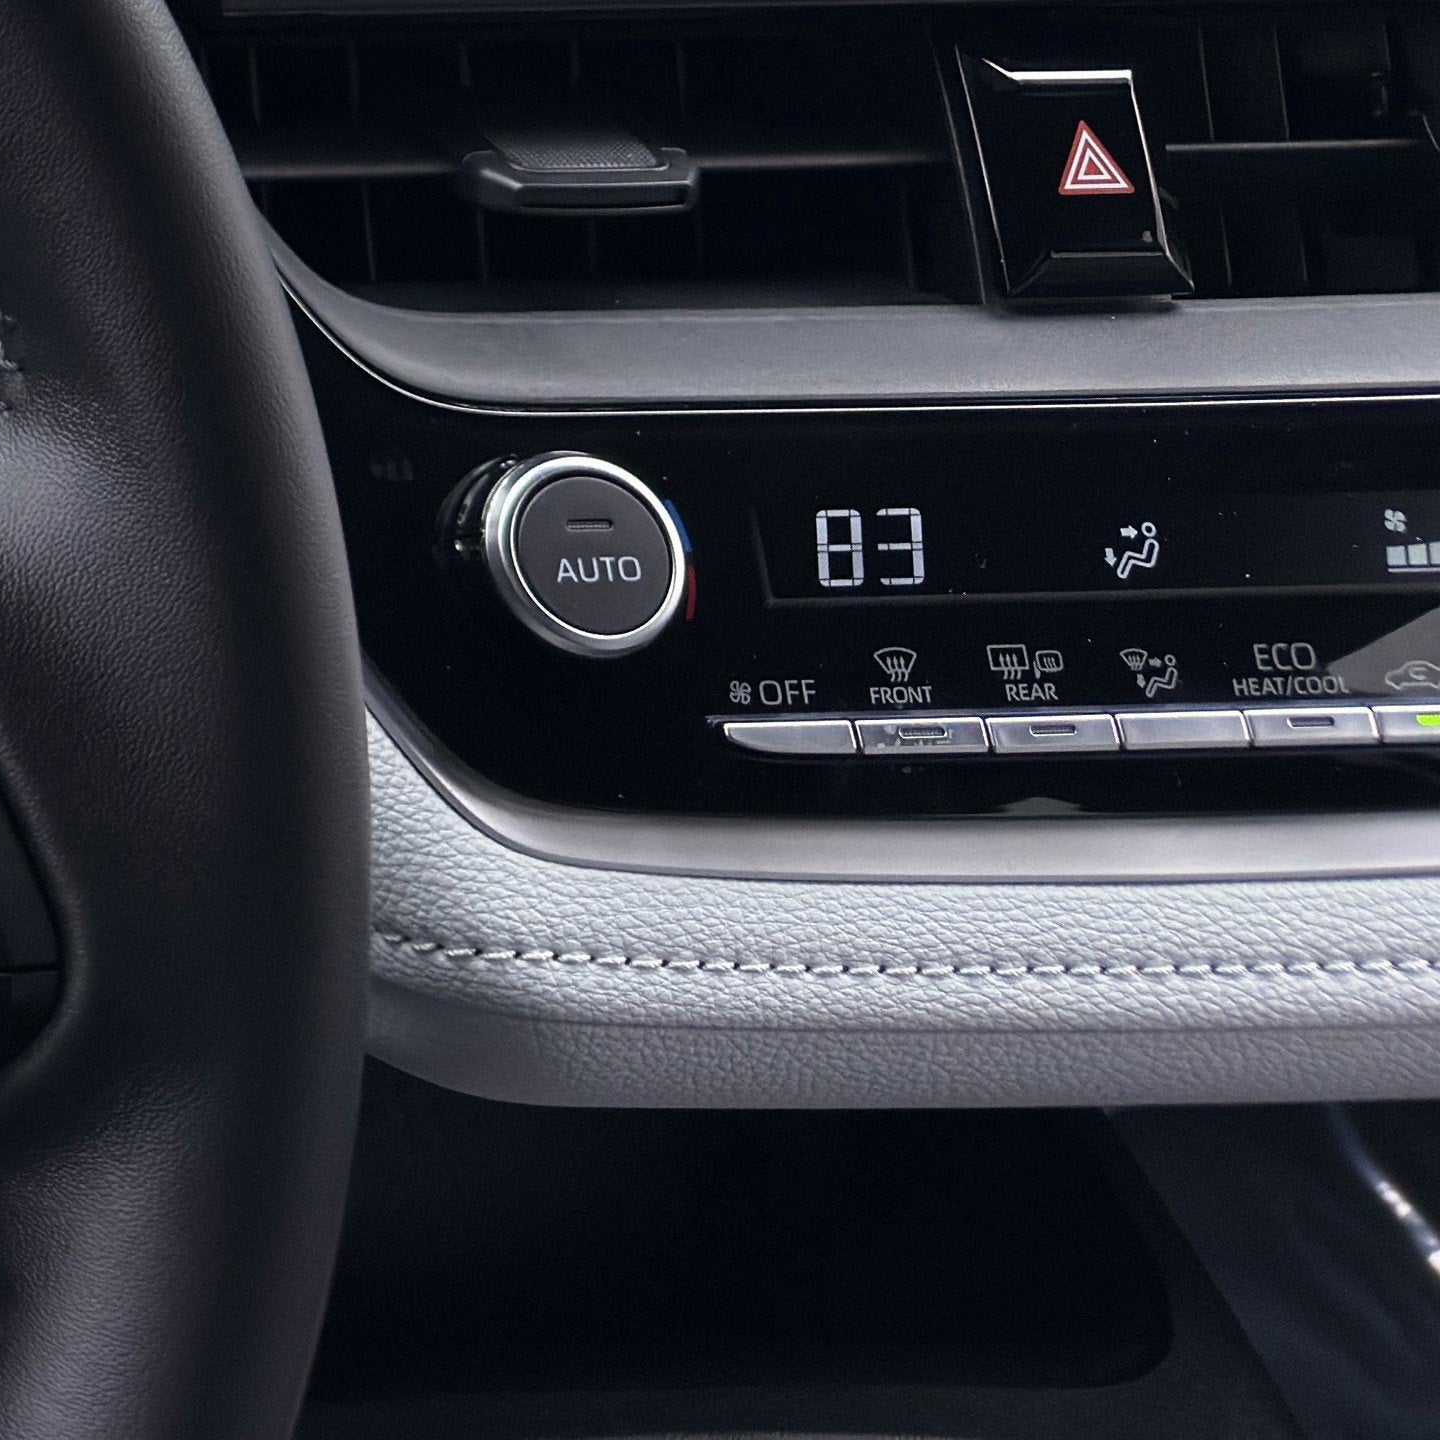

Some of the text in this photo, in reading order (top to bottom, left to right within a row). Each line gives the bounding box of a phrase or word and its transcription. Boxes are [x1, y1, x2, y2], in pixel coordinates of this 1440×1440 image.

[815, 507, 926, 587] 83
[557, 556, 641, 583] AUTO
[1254, 643, 1316, 671] ECO
[760, 680, 816, 704] OFF
[869, 685, 932, 704] FRONT
[1006, 683, 1059, 701] REAR
[1233, 676, 1349, 697] HEAT/COOL
